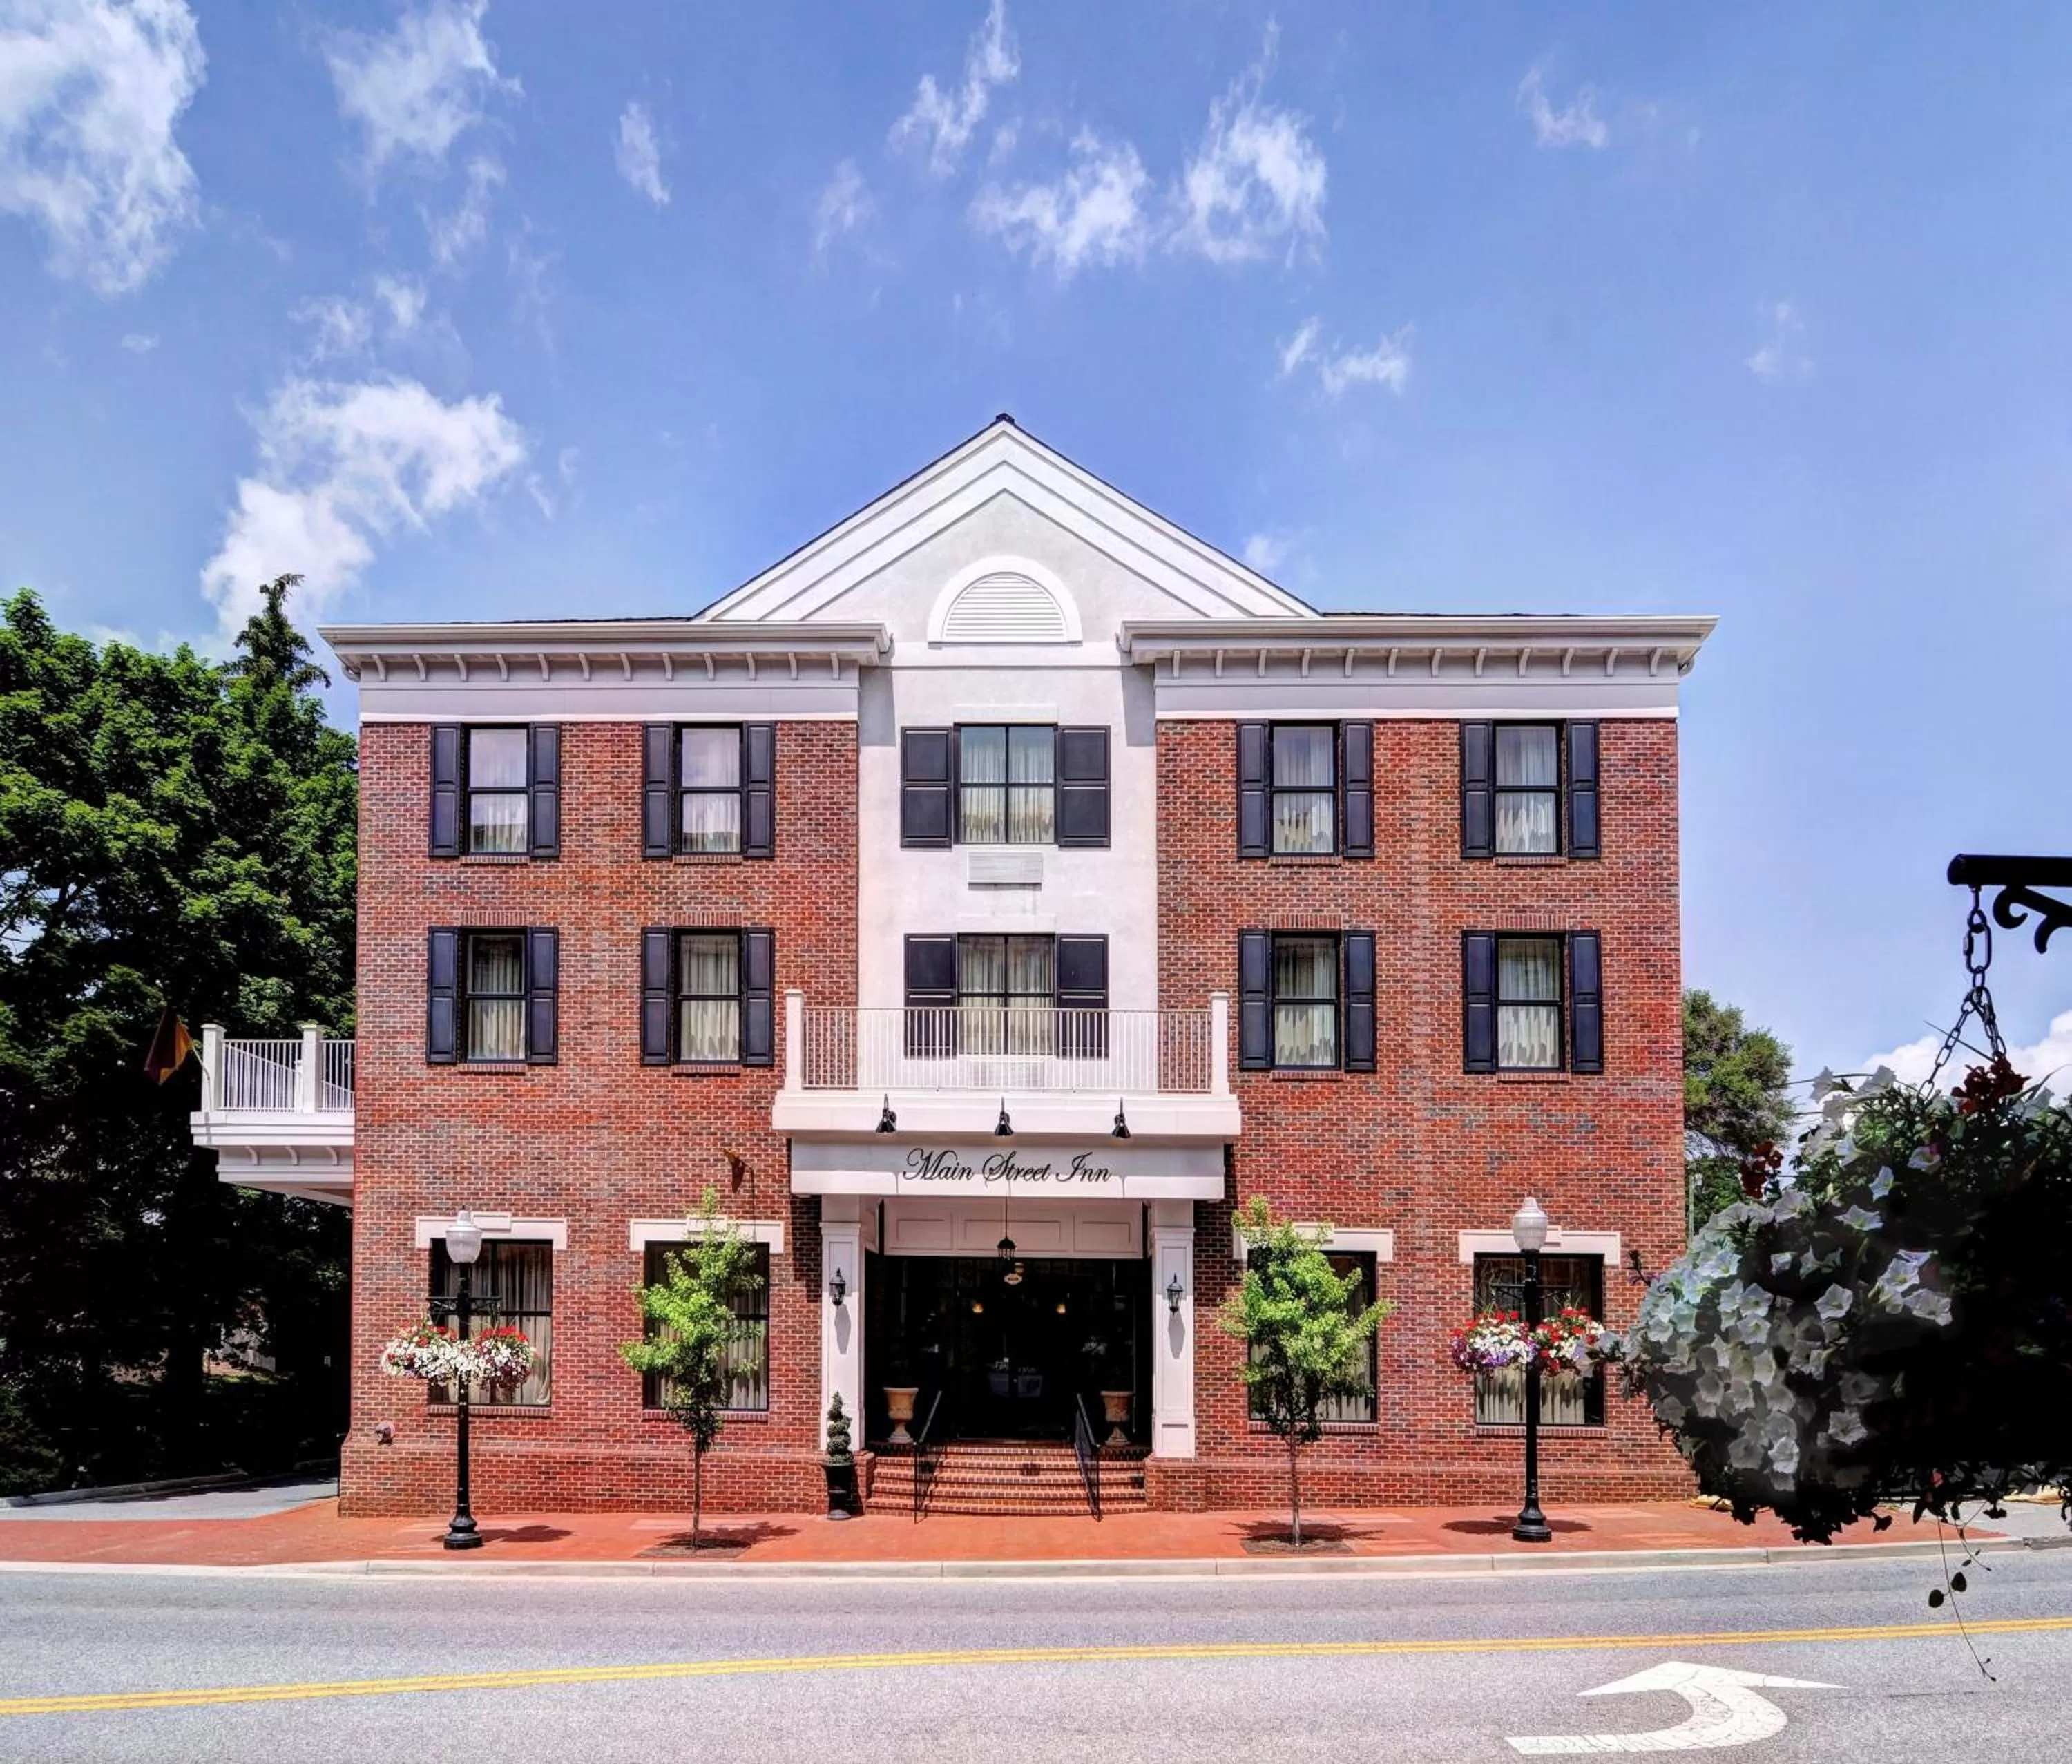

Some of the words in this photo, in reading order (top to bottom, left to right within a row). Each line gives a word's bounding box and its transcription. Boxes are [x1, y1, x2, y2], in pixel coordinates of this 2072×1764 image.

[903, 1147, 975, 1180] Main
[981, 1150, 1051, 1183] Street
[1055, 1151, 1112, 1182] Inn
